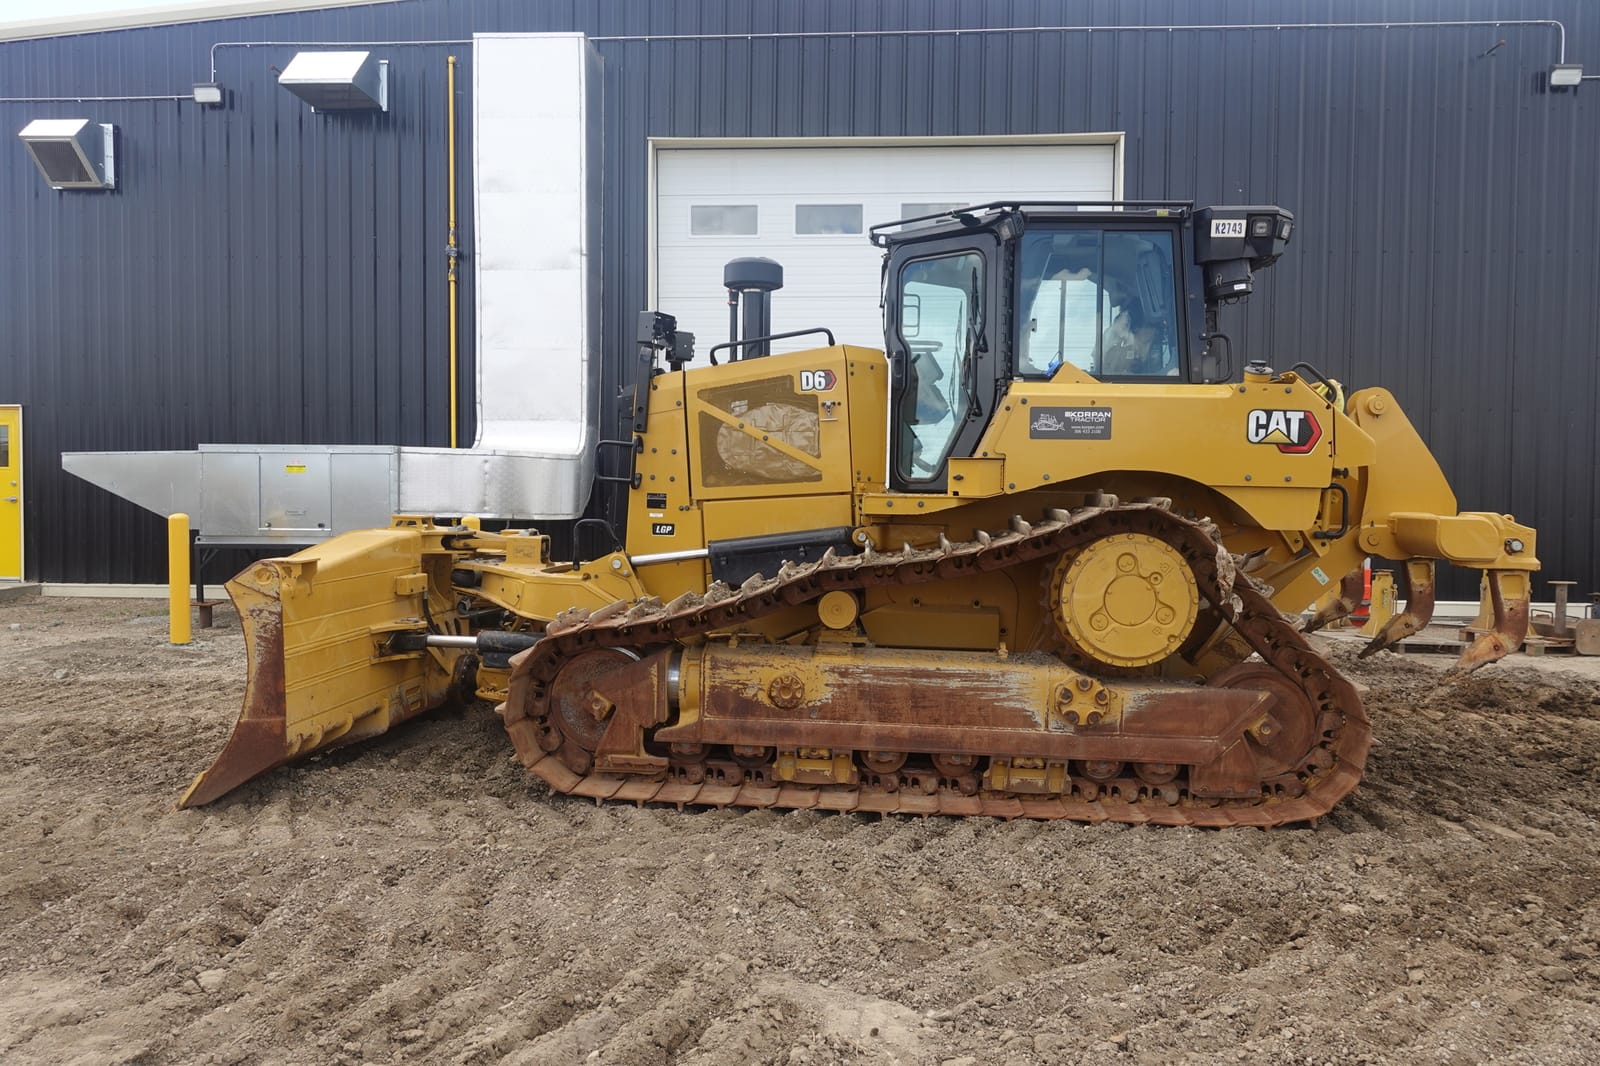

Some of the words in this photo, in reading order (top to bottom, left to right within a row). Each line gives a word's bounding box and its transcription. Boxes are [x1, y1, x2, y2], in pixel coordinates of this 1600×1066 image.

[1215, 222, 1243, 234] K2743
[801, 371, 826, 390] D6
[1248, 409, 1305, 444] CAT
[655, 525, 673, 534] LGP
